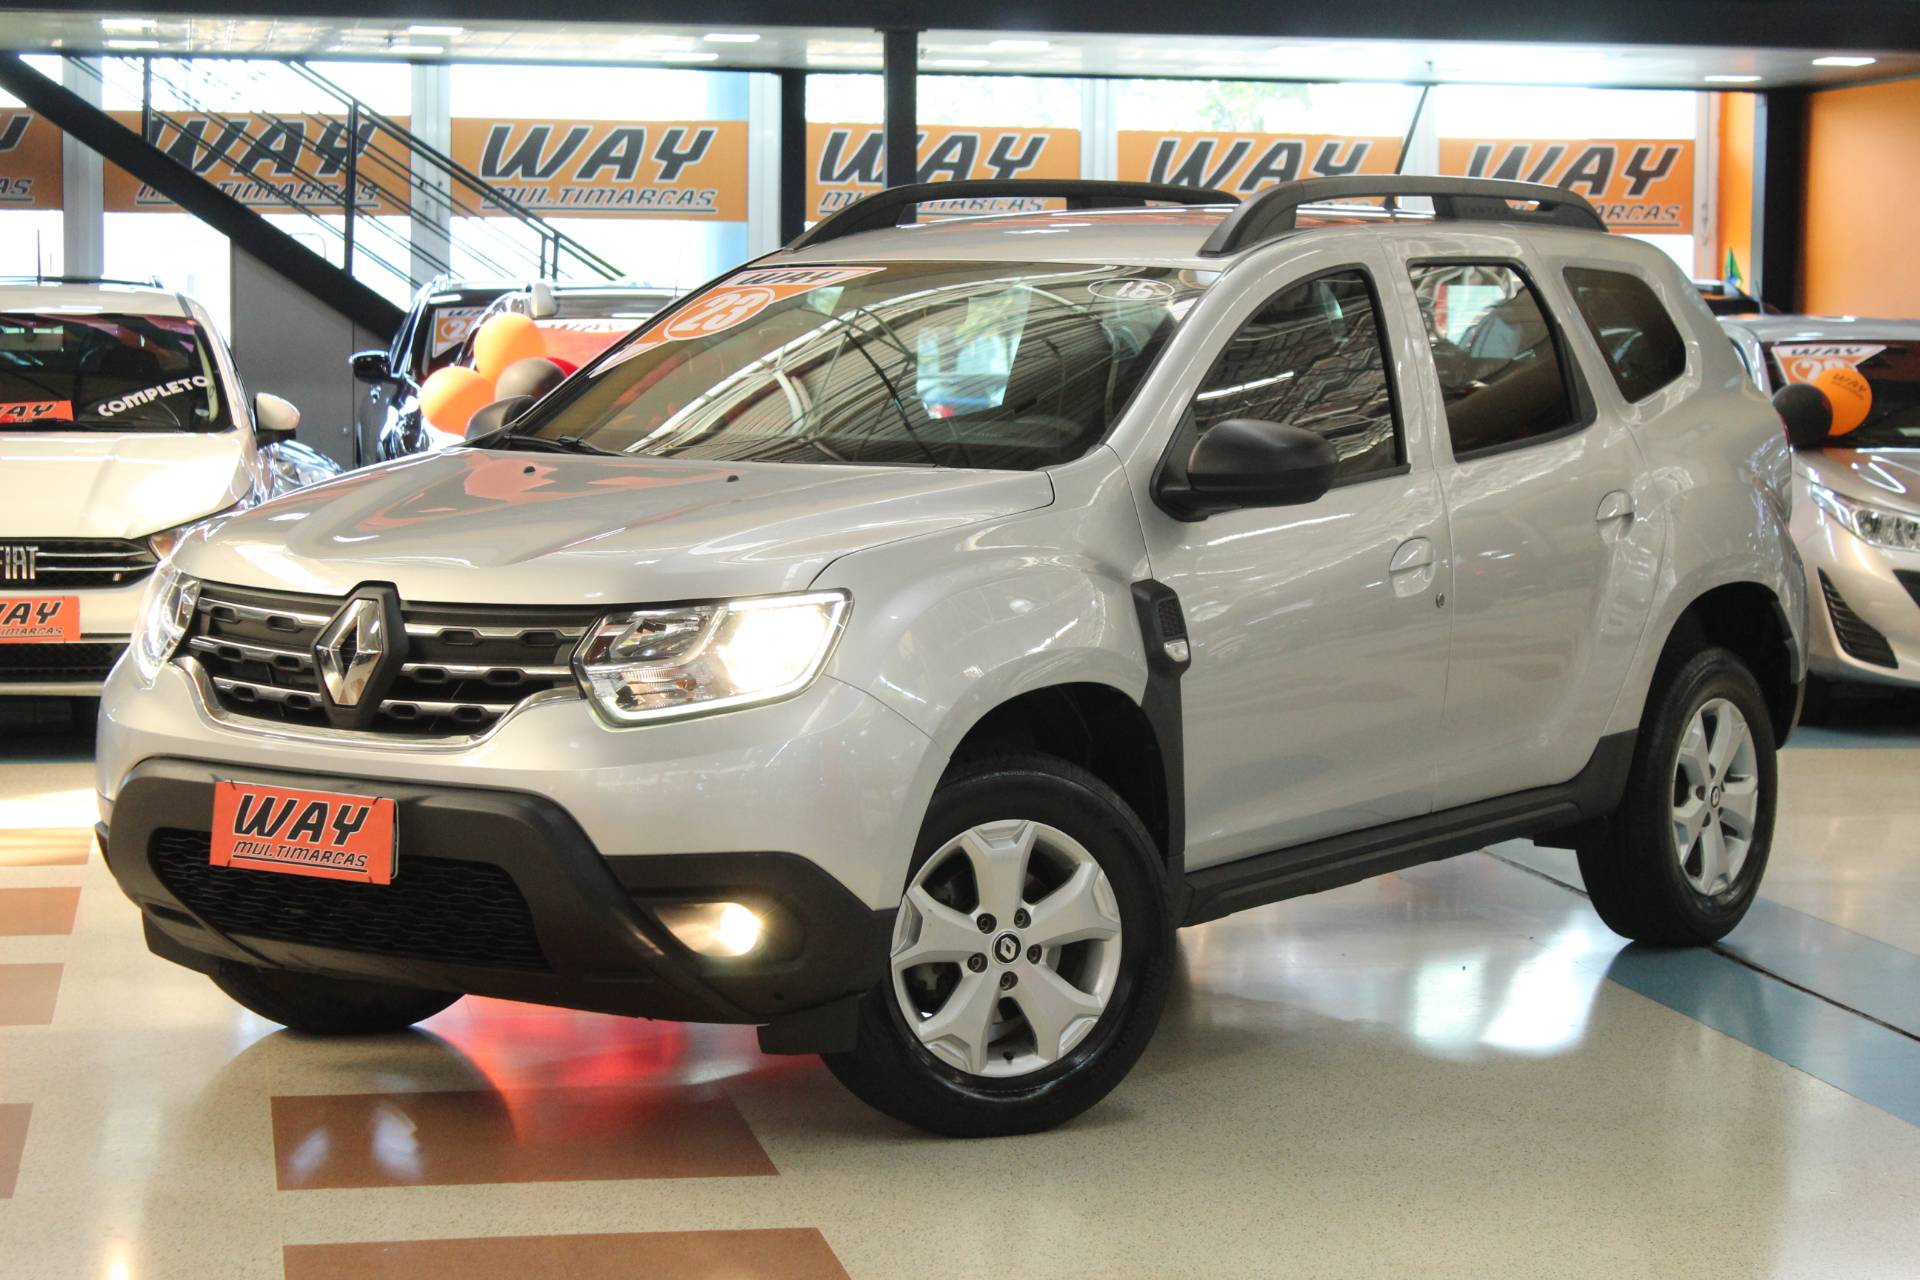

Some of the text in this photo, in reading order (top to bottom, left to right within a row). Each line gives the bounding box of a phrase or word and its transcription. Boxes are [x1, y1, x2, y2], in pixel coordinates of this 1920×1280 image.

[480, 125, 718, 182] WAY
[818, 129, 1049, 184] WAY
[1148, 138, 1372, 192] WAY
[1466, 143, 1682, 197] WAY
[484, 187, 716, 206] MULTIMARCAS
[737, 271, 841, 284] WAY
[669, 293, 769, 332] 23
[0, 403, 55, 417] AY
[97, 375, 209, 417] COMPLETO
[0, 546, 38, 579] IAT
[0, 601, 62, 625] AY
[233, 794, 371, 846] WAY
[233, 841, 368, 867] MULTIMARCAS
